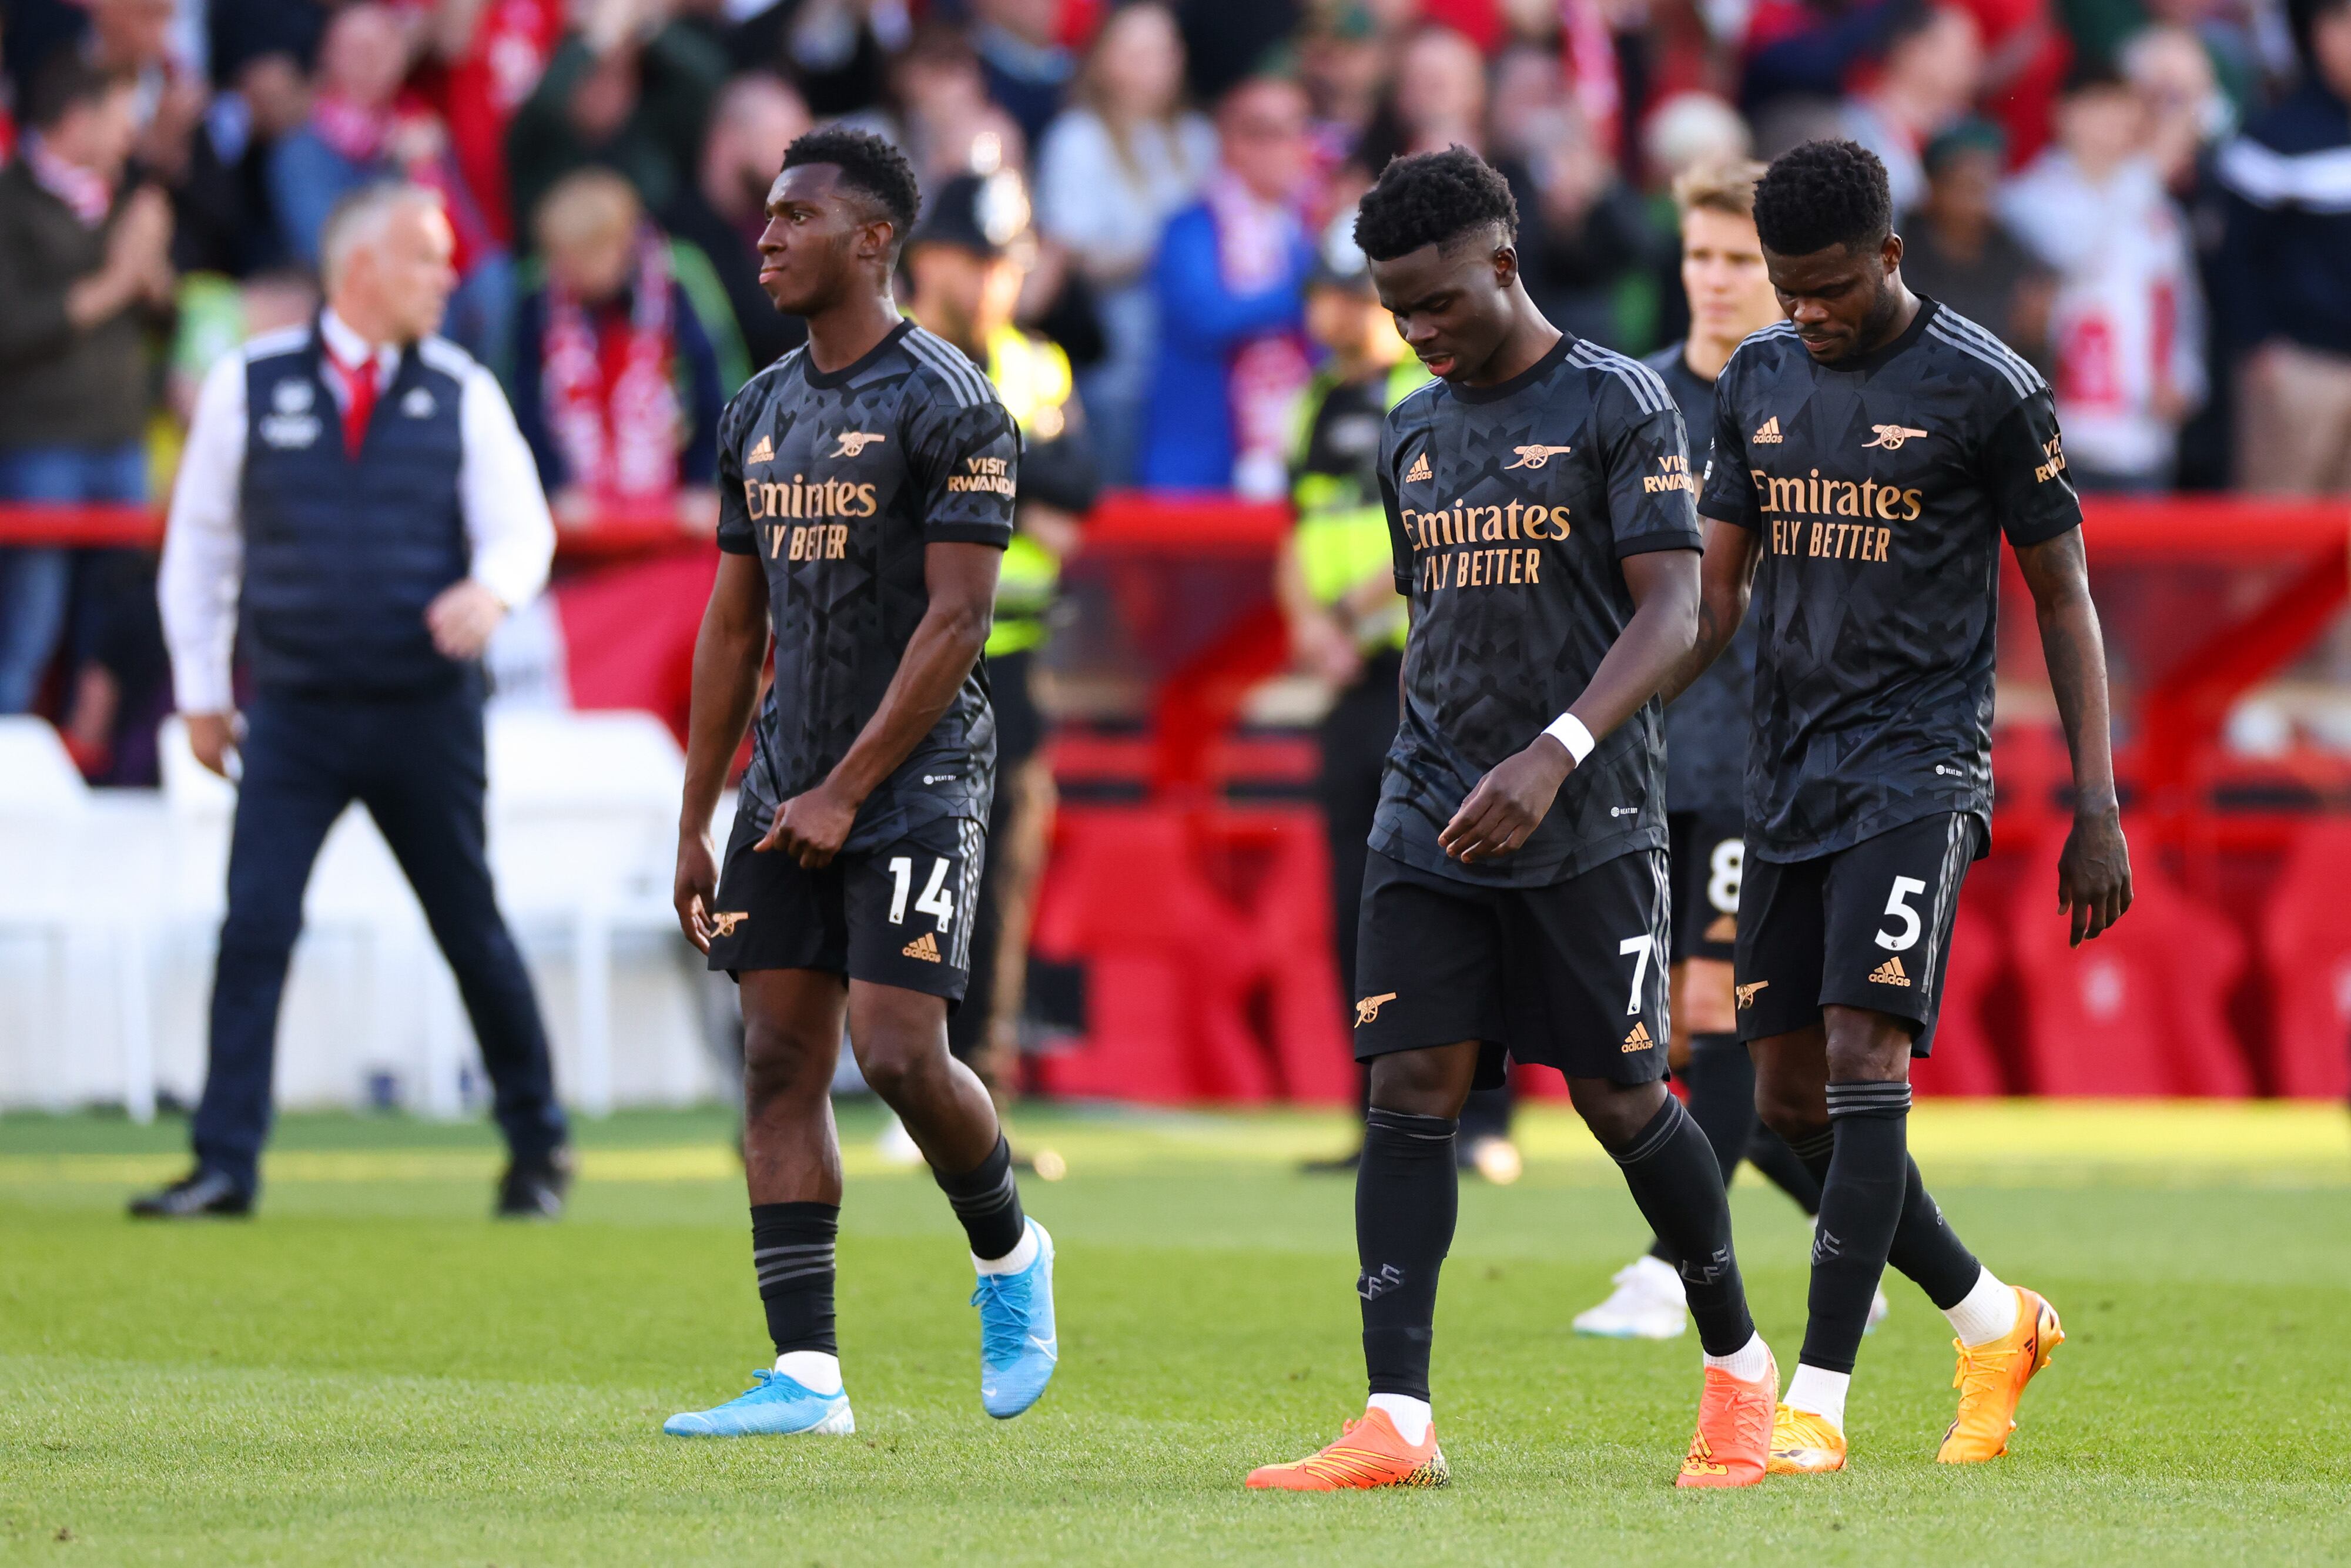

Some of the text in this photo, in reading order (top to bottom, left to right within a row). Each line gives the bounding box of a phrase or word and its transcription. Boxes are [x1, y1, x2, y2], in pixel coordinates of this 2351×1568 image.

[1753, 433, 1783, 444] adidas
[967, 456, 1007, 476] VISIT
[1406, 470, 1433, 483] adidas
[1643, 473, 1694, 493] RWAND
[1750, 468, 1923, 521] Emirates
[1401, 497, 1571, 551] Emirates
[1773, 520, 1891, 562] FLY BETTER
[1456, 548, 1540, 588] BETTER
[889, 856, 955, 933] 14
[1707, 838, 1745, 914] 8
[1874, 875, 1926, 951] 5
[902, 946, 942, 963] adidas
[1619, 934, 1652, 1016] 7
[1868, 973, 1911, 987] adidas
[1621, 1040, 1653, 1053] adidas
